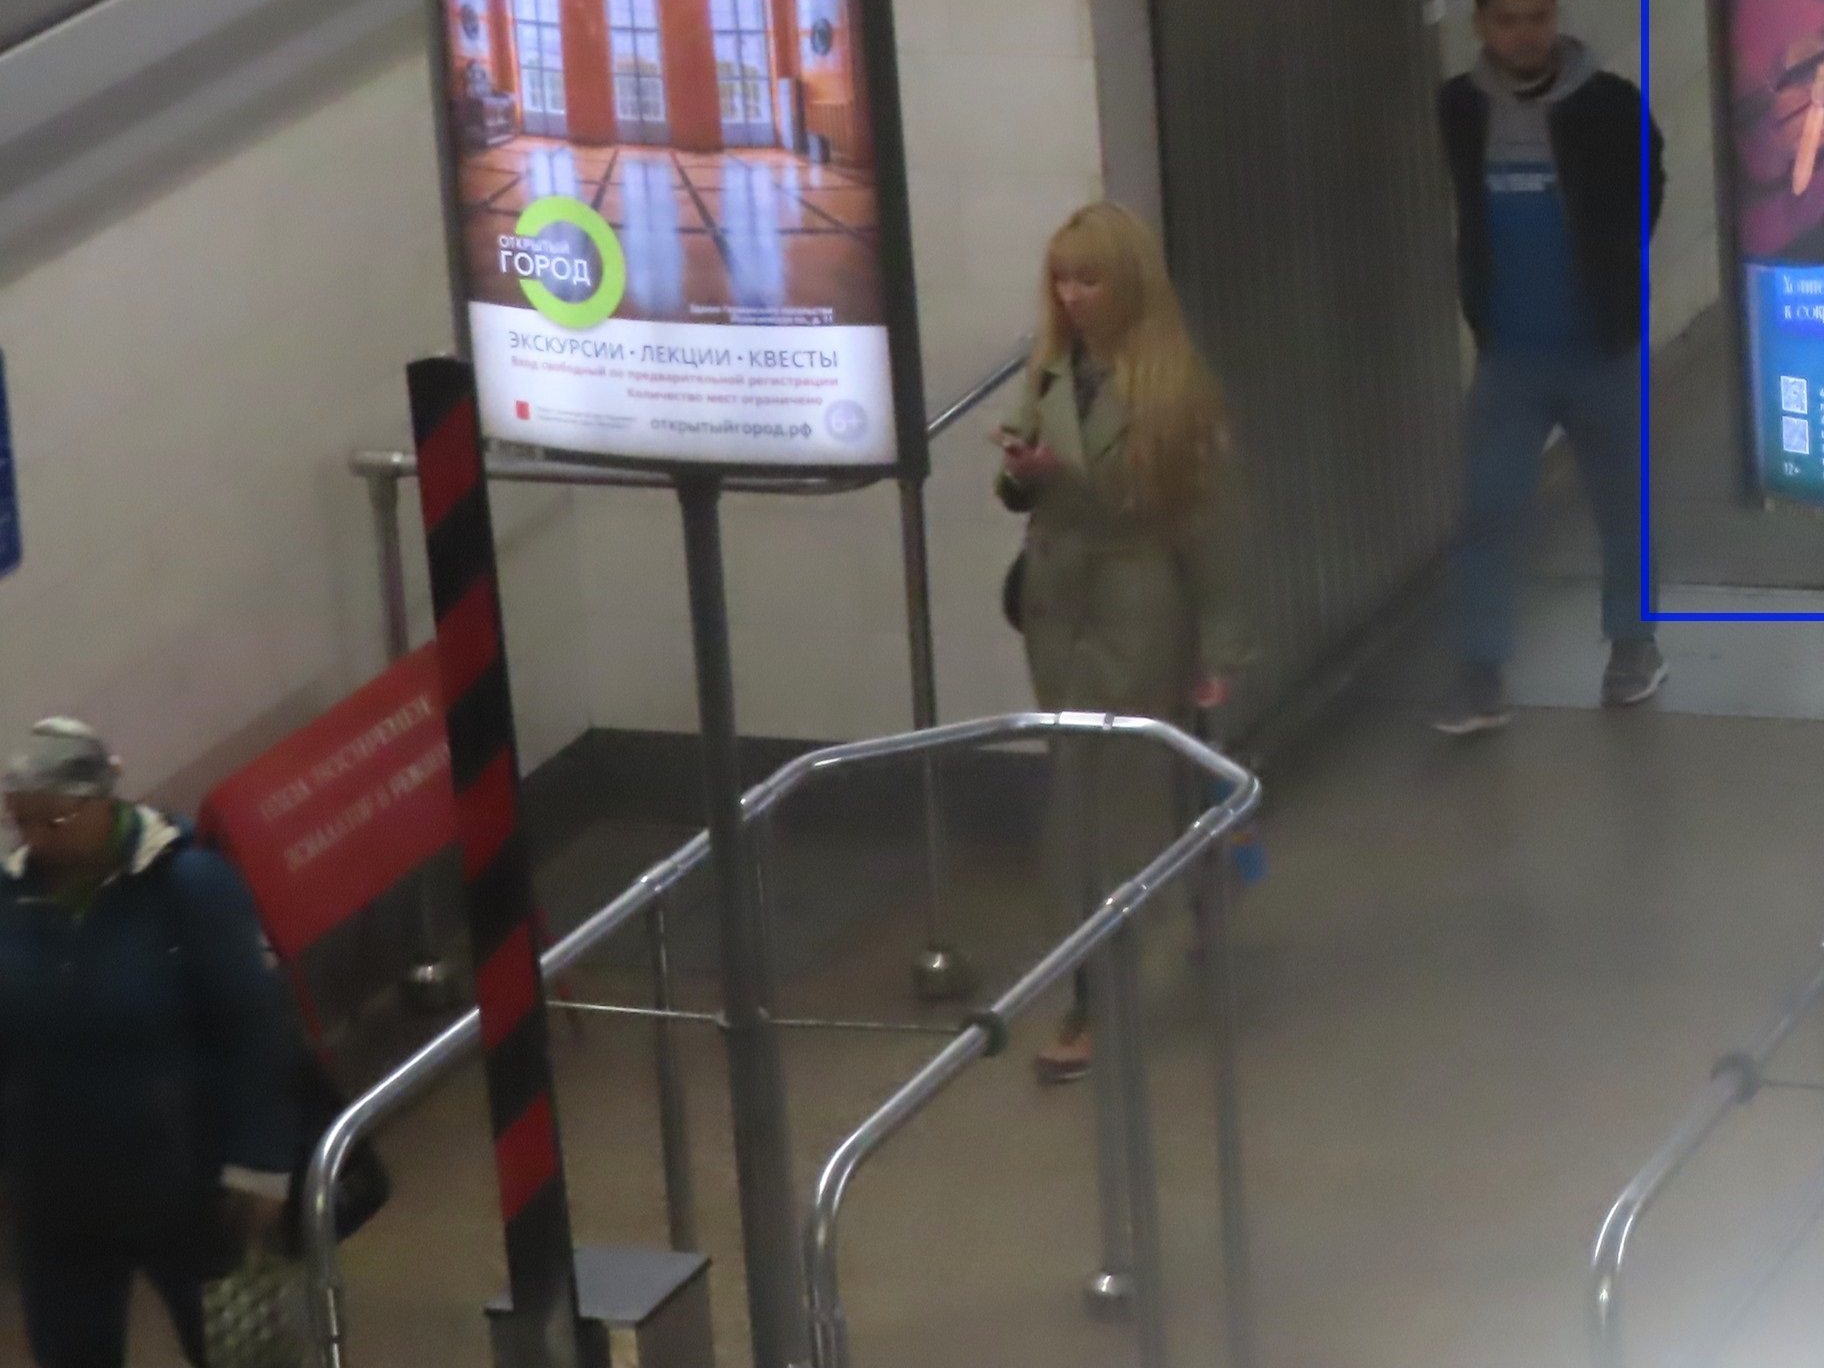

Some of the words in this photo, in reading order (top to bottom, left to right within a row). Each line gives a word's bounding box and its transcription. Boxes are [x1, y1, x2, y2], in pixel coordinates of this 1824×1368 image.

[500, 250, 592, 286] ГОРОД
[1784, 305, 1792, 319] к
[508, 330, 624, 361] ЭКСКУРСИИ
[640, 344, 731, 368] ЛЕКЦИИ
[749, 349, 838, 369] КВЕСТЫ
[650, 418, 812, 439] открытыйгород.рф
